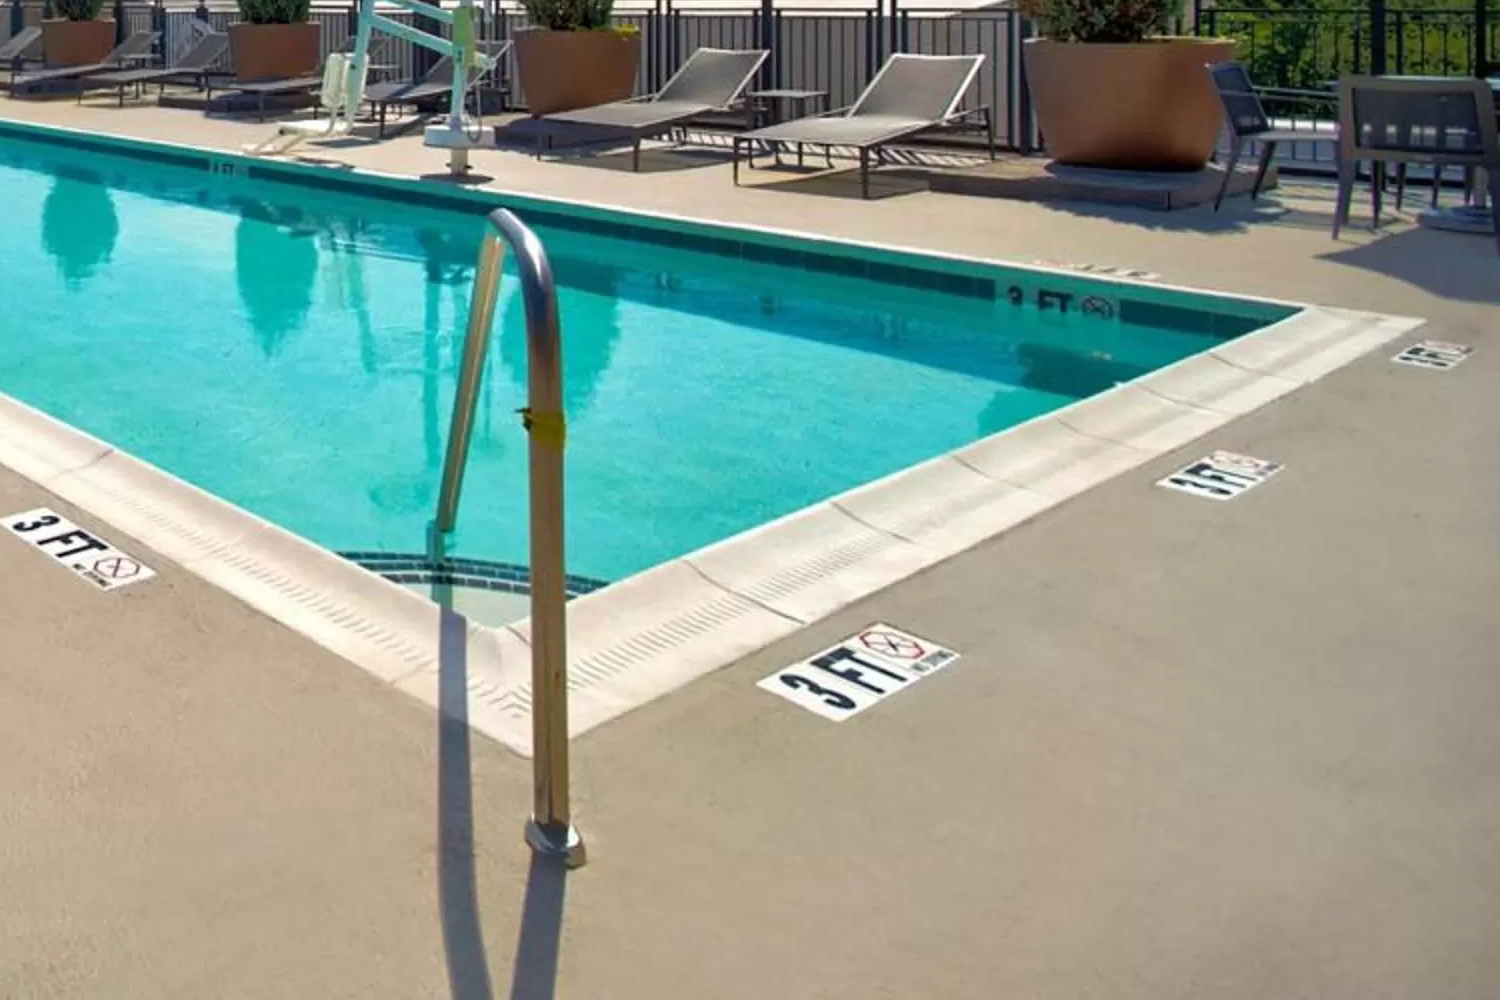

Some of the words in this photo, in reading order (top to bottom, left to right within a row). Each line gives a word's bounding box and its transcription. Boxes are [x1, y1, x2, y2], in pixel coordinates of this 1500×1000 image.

[1184, 462, 1258, 488] FT
[12, 514, 61, 532] 3
[36, 529, 109, 558] FT
[809, 646, 909, 695] FT
[779, 673, 857, 710] 3
